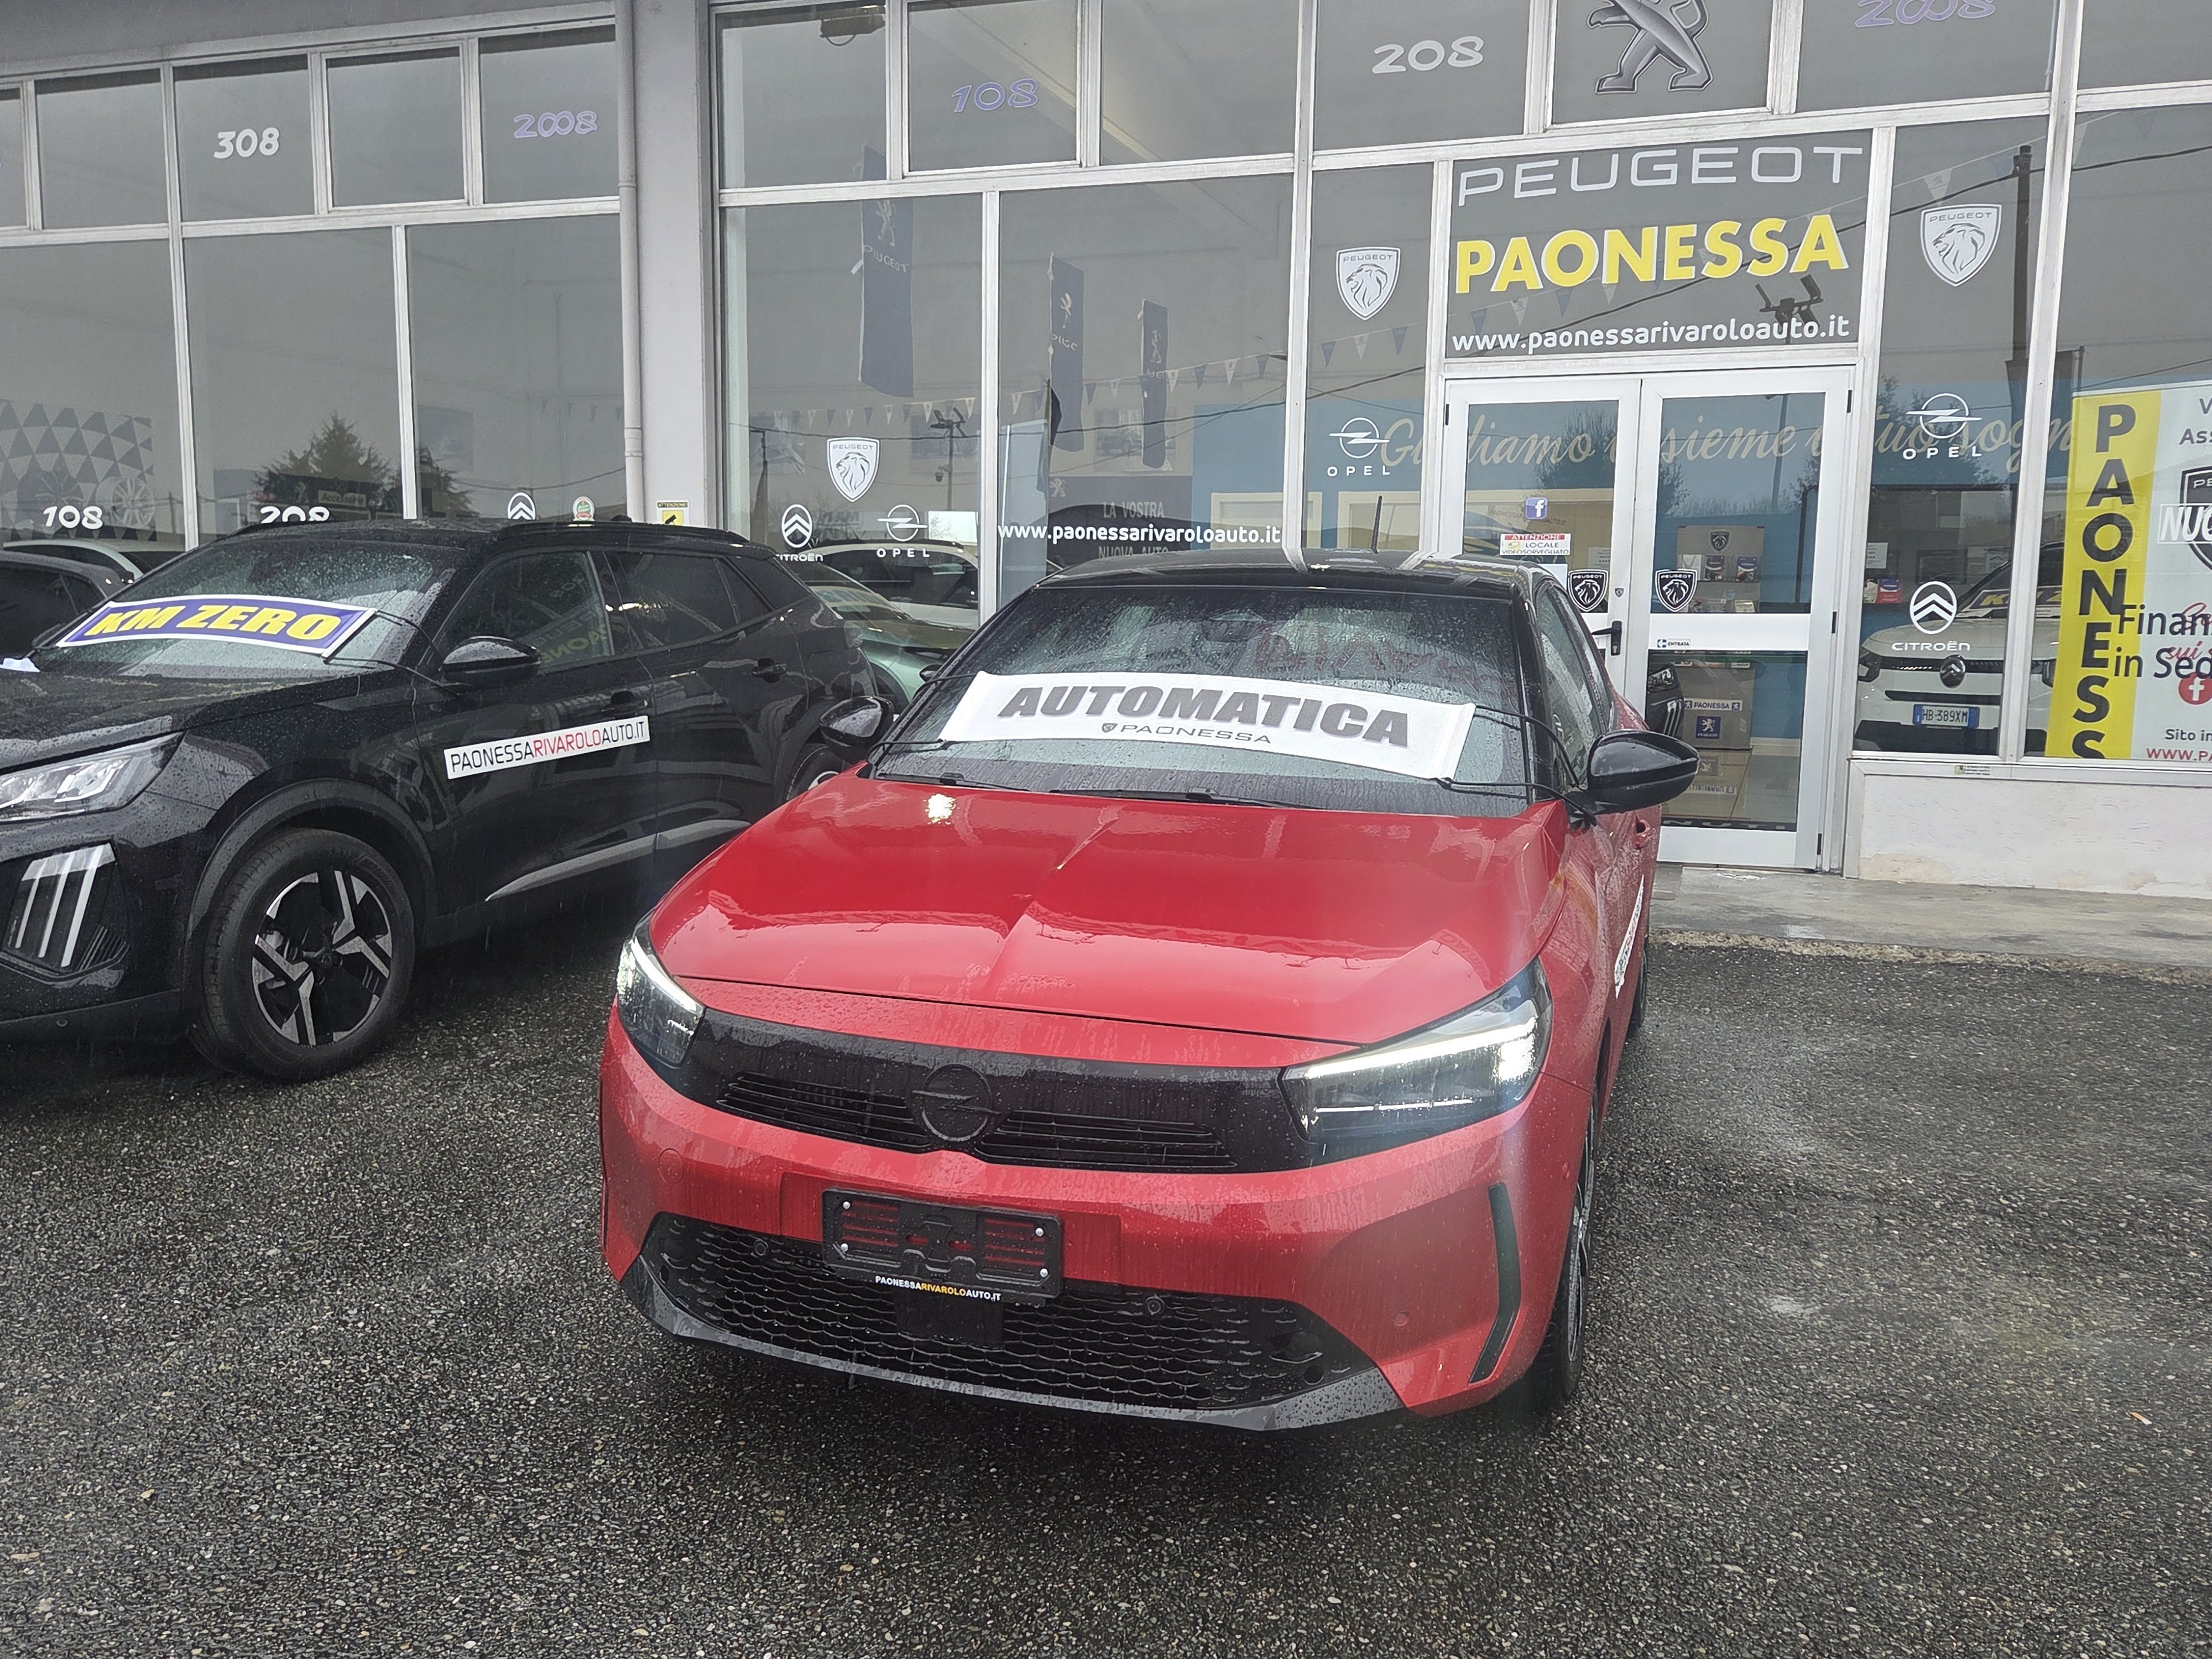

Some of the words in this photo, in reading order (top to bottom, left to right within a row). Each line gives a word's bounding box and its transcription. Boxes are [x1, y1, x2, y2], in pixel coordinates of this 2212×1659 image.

[1372, 36, 1484, 74] 208
[951, 78, 1039, 112] 108
[514, 111, 598, 138] 2008
[213, 128, 280, 159] 308
[1458, 147, 1863, 206] PEUGEOT
[1929, 211, 1993, 223] PEUGEOT
[1343, 253, 1393, 263] PEUGEOT
[1455, 214, 1849, 294] PAONESSA
[1452, 315, 1850, 354] www.paonessarivaroloauto.it
[1902, 446, 1983, 460] OPEL
[1327, 466, 1390, 477] OPEL
[43, 505, 103, 529] 108
[260, 505, 330, 524] 208
[1122, 502, 1165, 518] VOSTRA
[997, 524, 1281, 545] www.paonessarivaroloauto.it
[876, 548, 930, 557] OPEL
[84, 606, 186, 636] KM
[176, 604, 342, 640] ZERO
[2114, 646, 2143, 677] in
[997, 685, 1409, 747] AUTOMATICA
[450, 721, 644, 773] PAONESSARIVAROLOAUTO.IT
[1120, 724, 1272, 744] PAONESSA
[2165, 729, 2196, 740] Sito
[875, 1275, 1001, 1301] PAONESSARIVAROLOAUTO.IT
